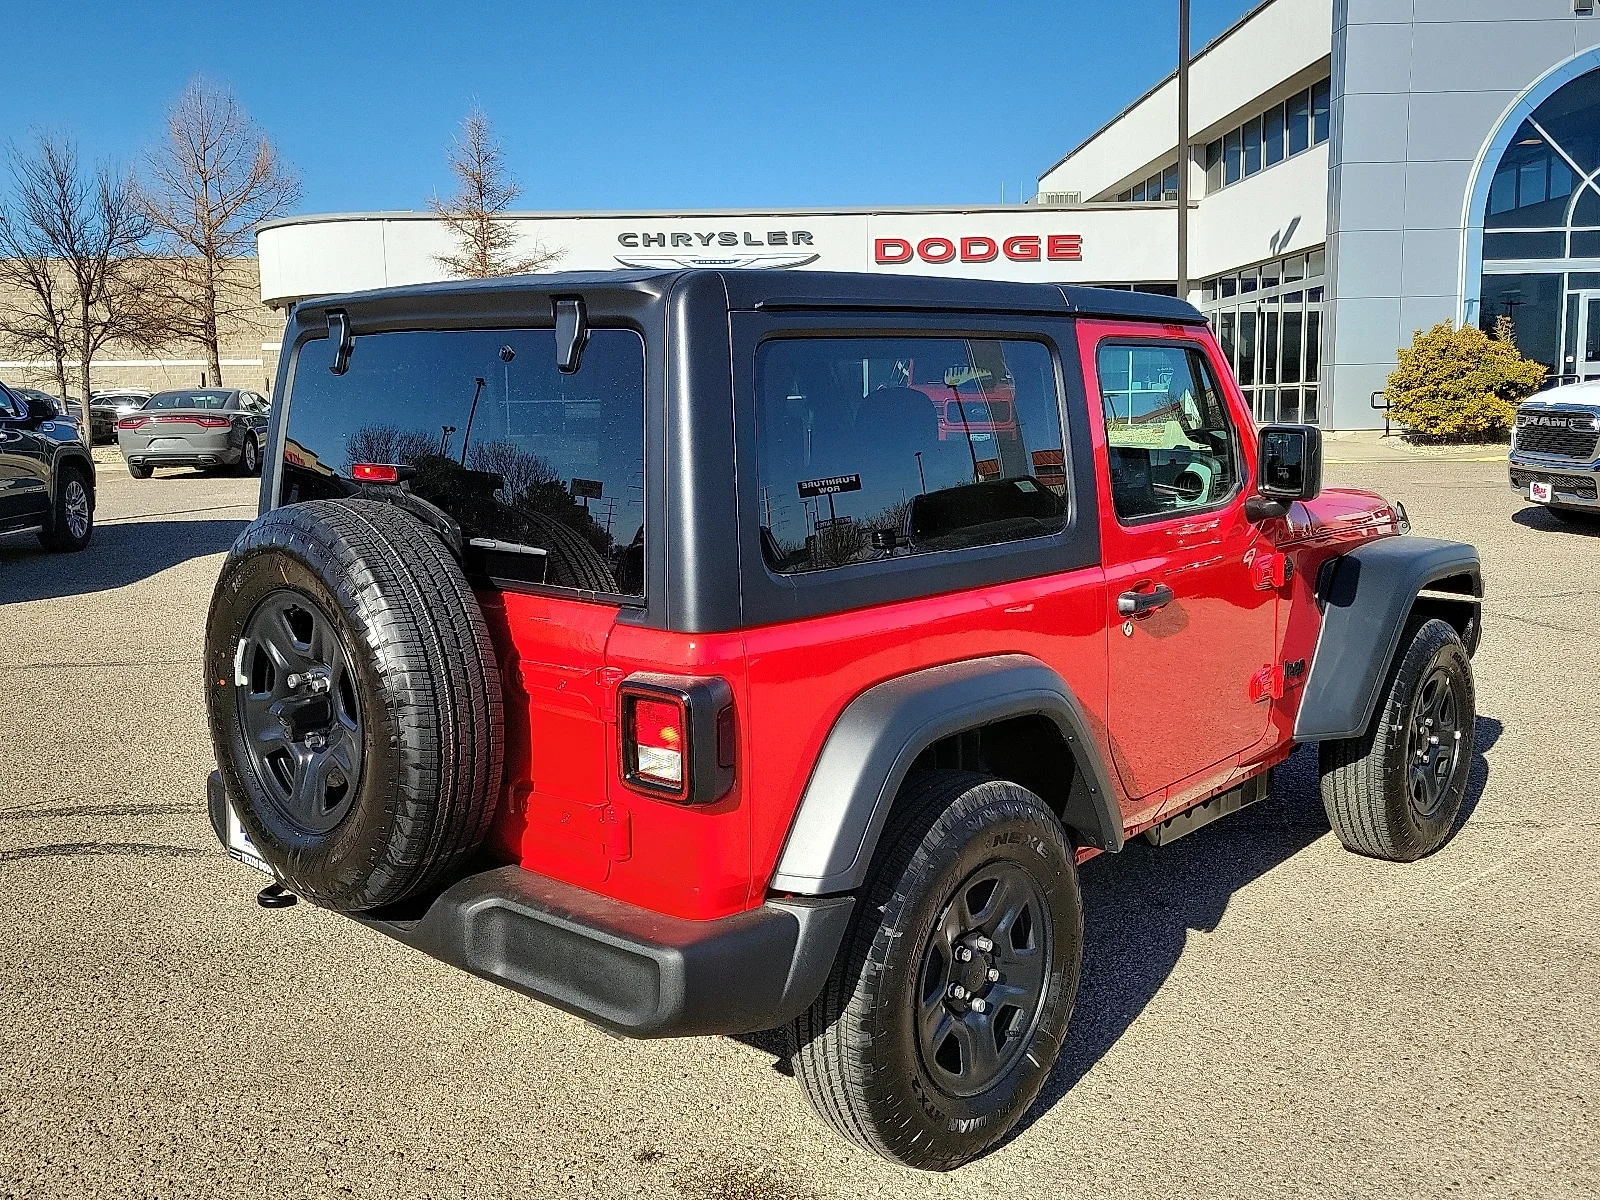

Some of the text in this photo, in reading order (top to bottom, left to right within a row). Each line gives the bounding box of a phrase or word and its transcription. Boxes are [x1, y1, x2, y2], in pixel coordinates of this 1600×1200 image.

[617, 230, 815, 248] CHRYSLER
[874, 234, 1083, 263] DODGE
[1527, 416, 1567, 428] RAM
[992, 831, 1051, 860] NEXE
